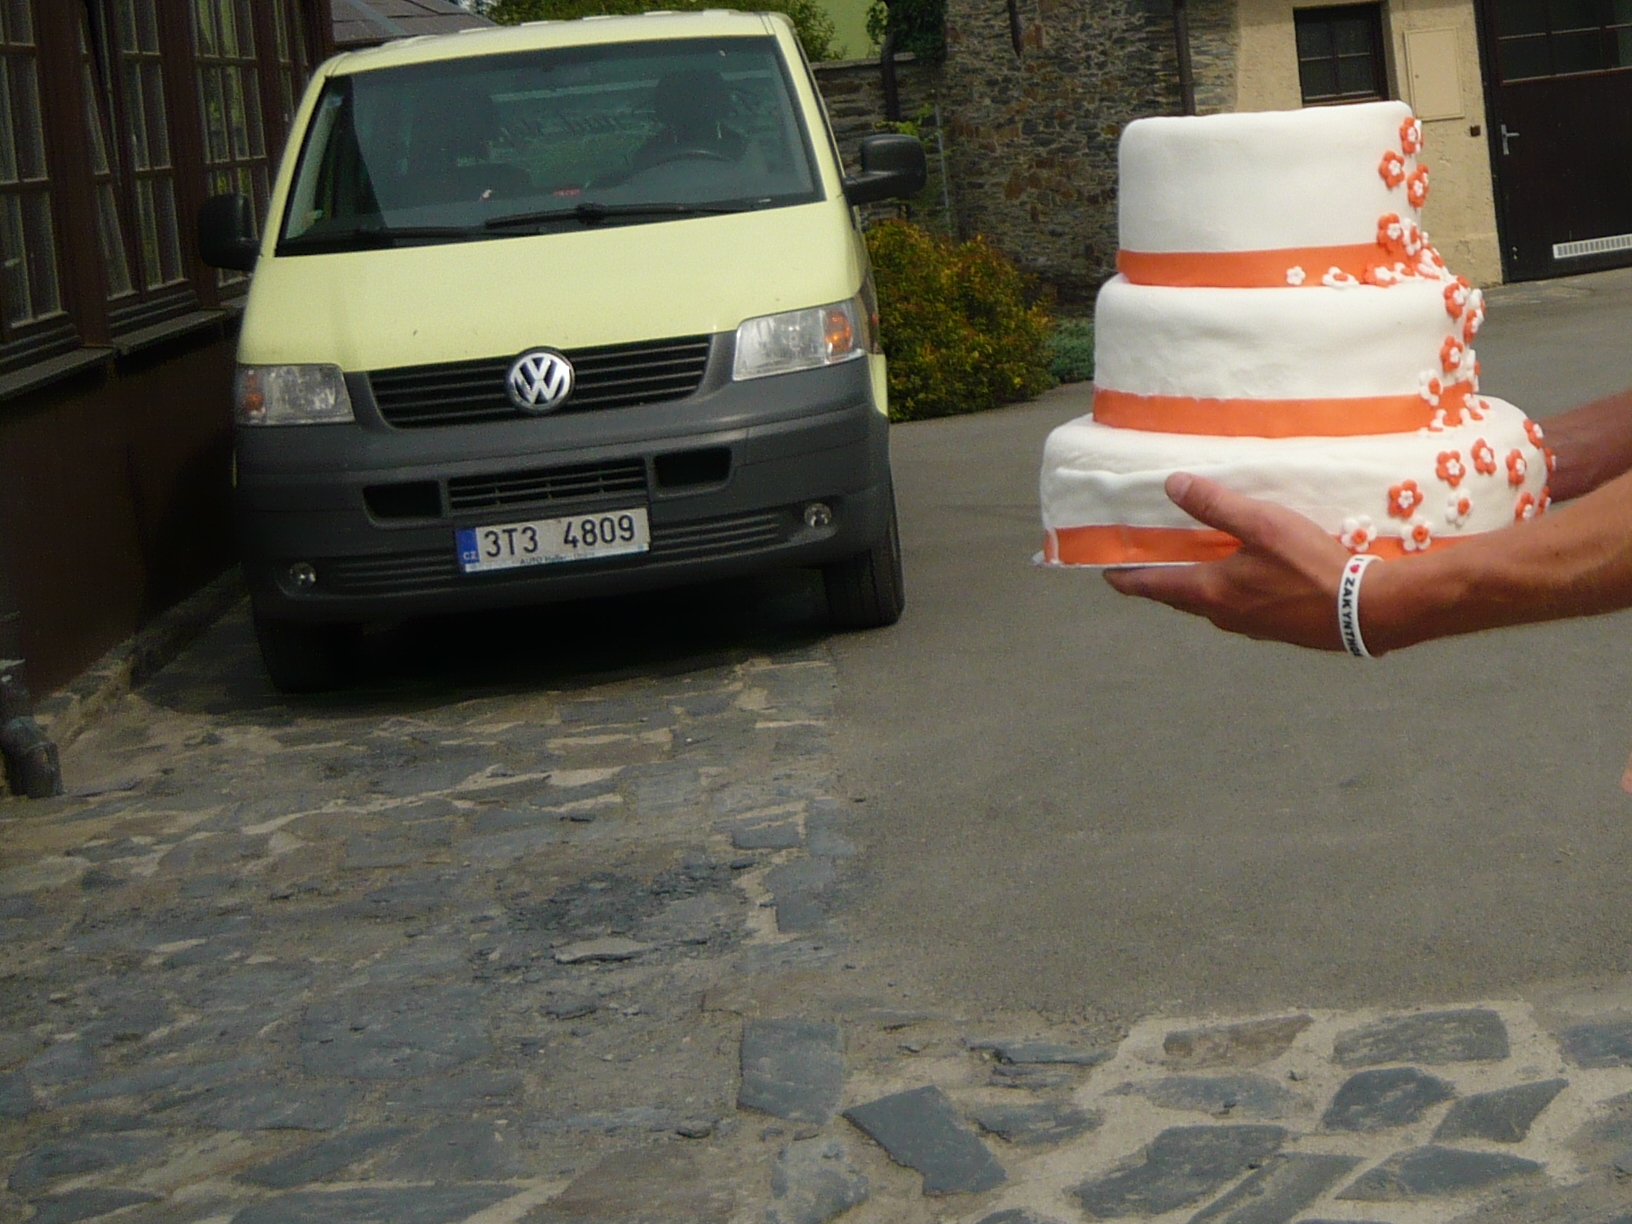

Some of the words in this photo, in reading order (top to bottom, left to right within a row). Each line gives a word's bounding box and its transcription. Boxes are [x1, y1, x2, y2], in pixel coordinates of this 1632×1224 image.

[484, 526, 539, 559] 3T3
[563, 514, 635, 549] 4809
[463, 550, 477, 561] CZ
